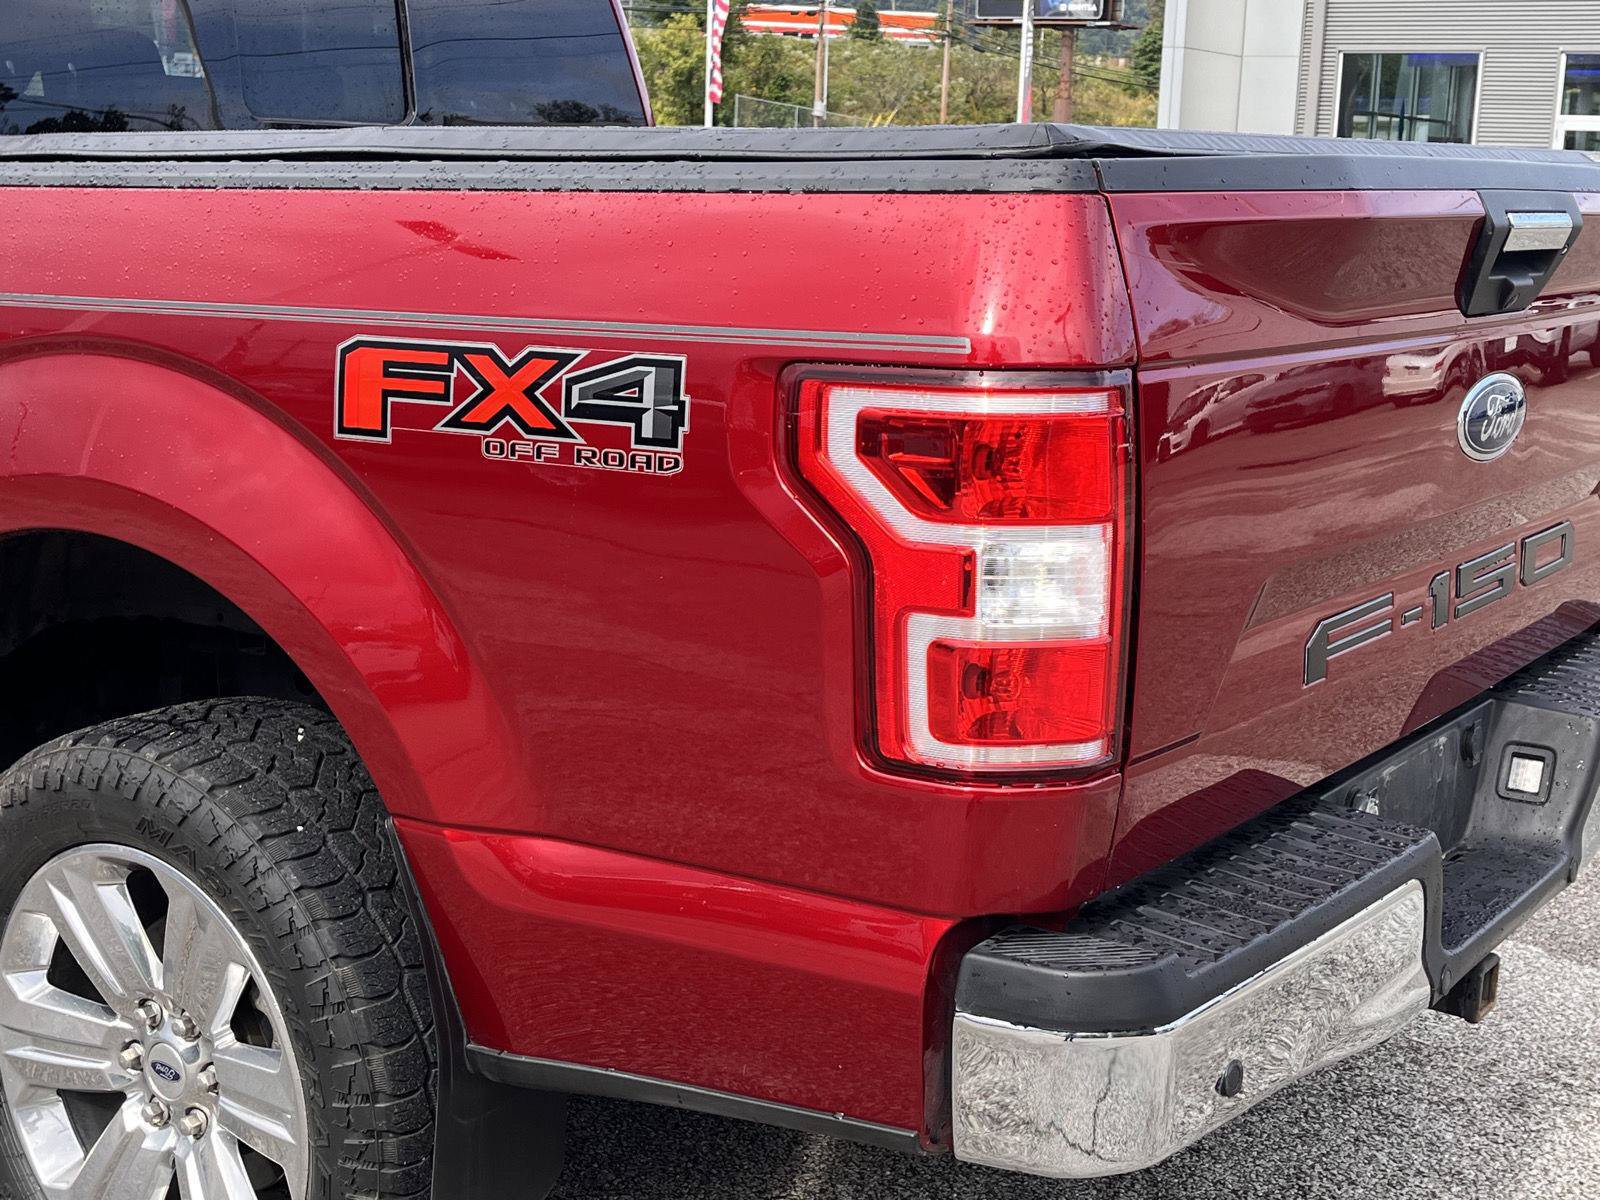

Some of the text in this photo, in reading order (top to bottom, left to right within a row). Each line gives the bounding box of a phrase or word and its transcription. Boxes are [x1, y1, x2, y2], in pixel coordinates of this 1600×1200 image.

[334, 334, 691, 450] FX4
[1480, 389, 1519, 442] Ford
[483, 437, 684, 474] OFF ROAD
[1303, 520, 1576, 689] F-150
